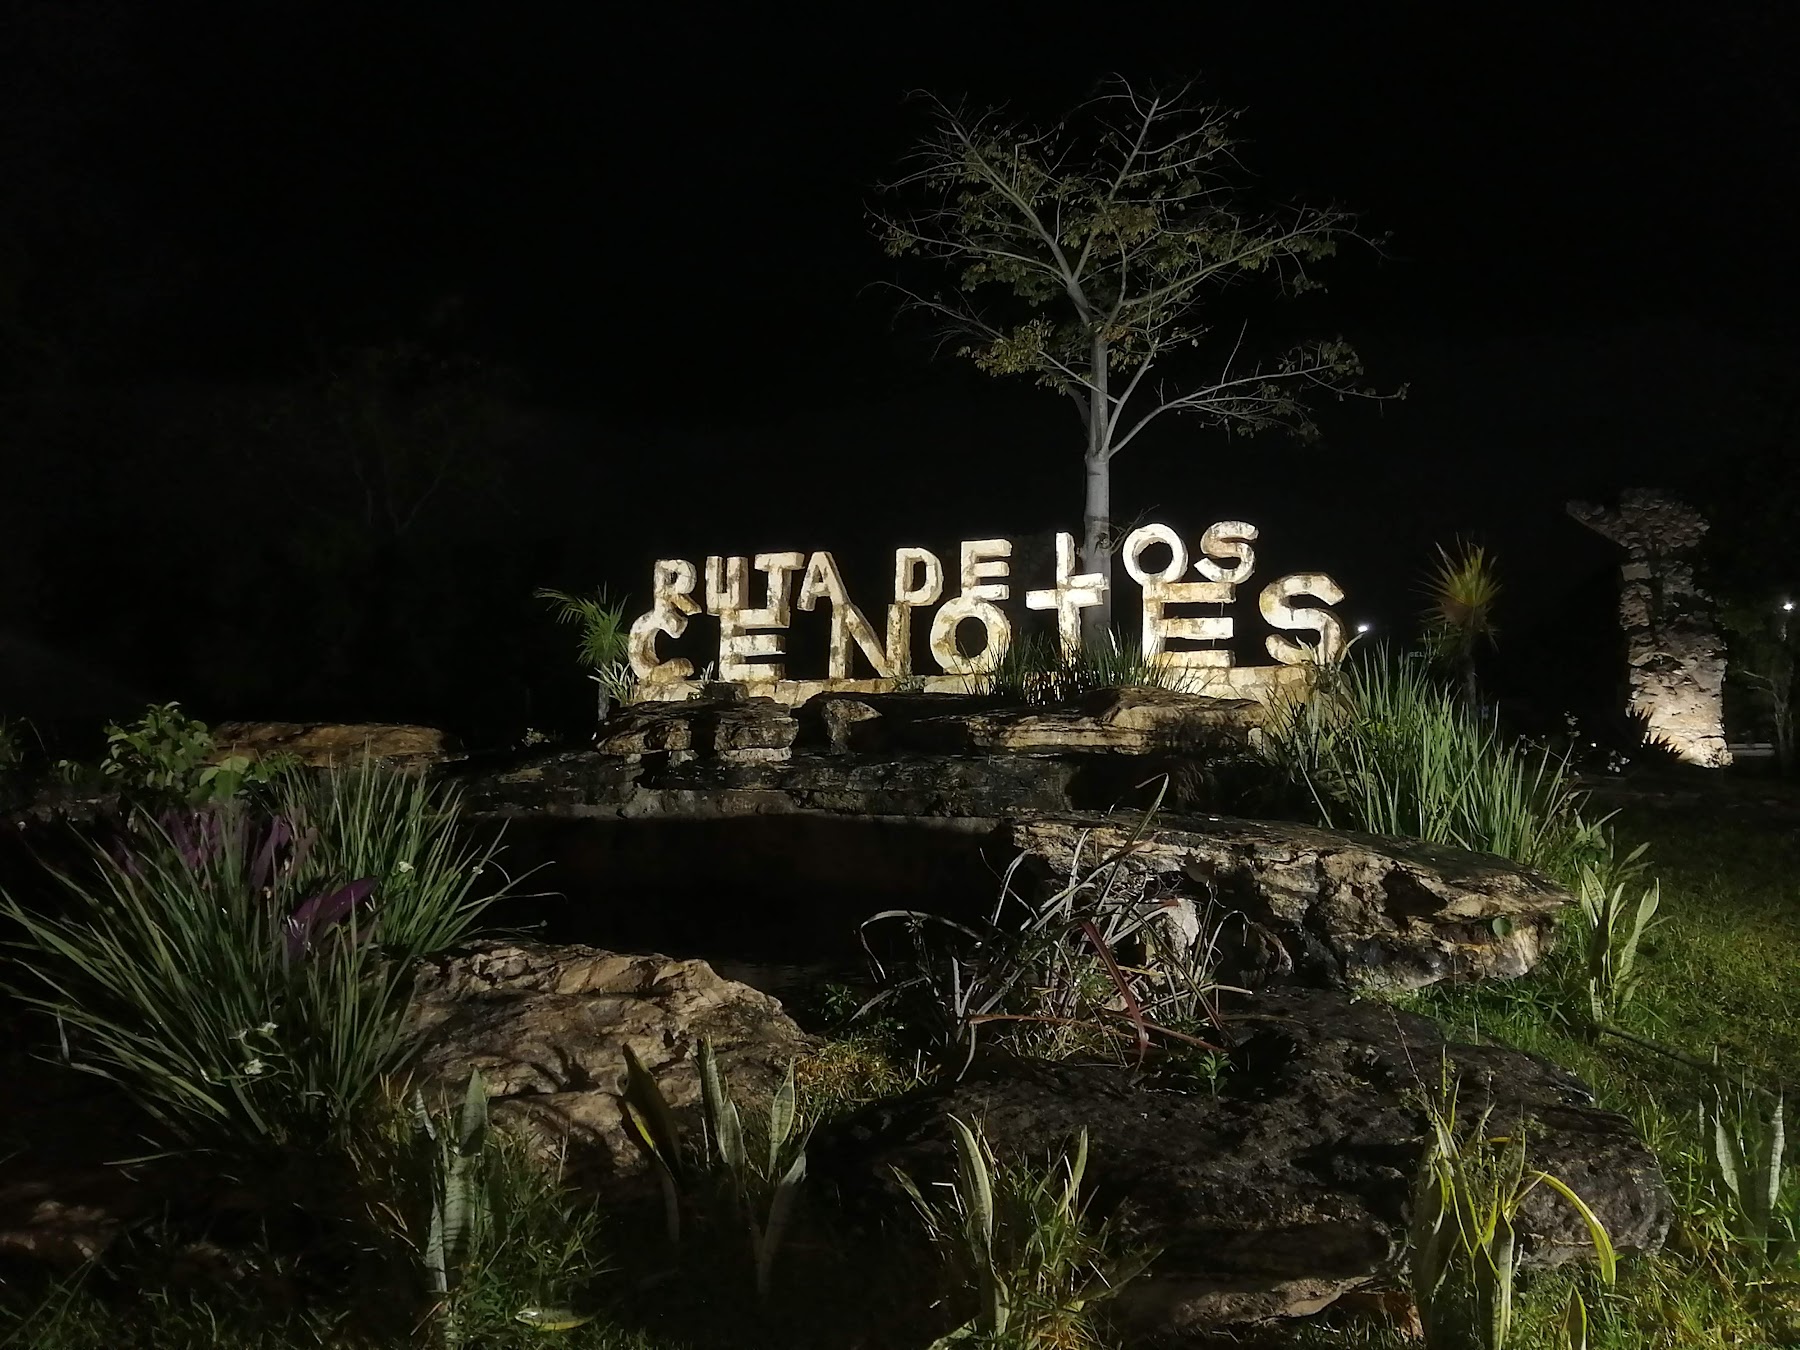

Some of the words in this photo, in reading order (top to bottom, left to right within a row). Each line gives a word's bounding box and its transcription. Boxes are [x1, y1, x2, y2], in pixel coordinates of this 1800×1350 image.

[653, 551, 849, 618] RUTA
[895, 539, 1012, 606] DE
[1055, 520, 1259, 590] LOS
[628, 572, 1346, 684] CENOTES
